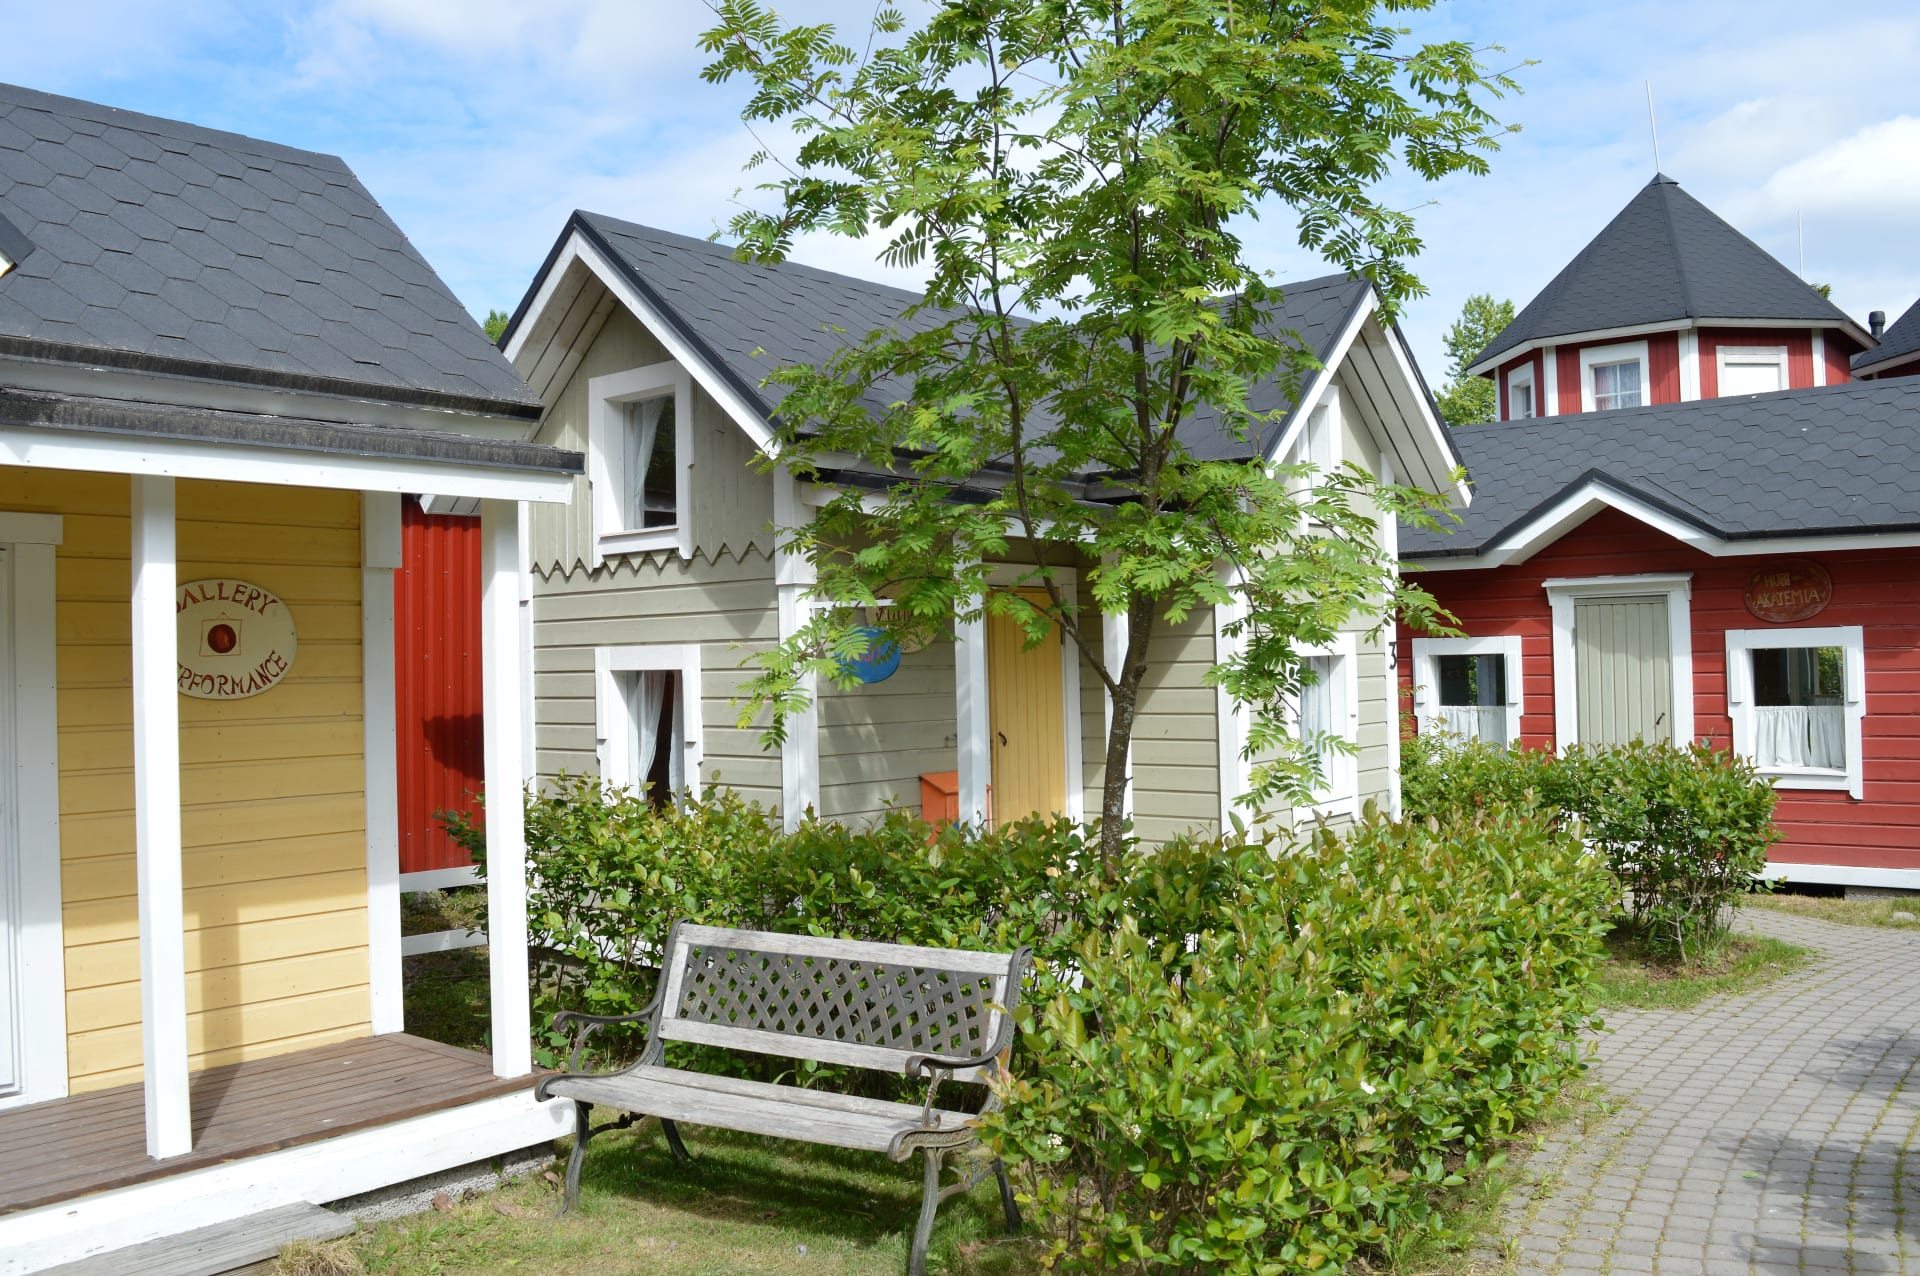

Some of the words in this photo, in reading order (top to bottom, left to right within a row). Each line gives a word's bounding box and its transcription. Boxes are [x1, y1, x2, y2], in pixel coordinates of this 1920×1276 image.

[1754, 588, 1820, 608] AKATEMIA
[1389, 642, 1397, 670] 3
[177, 650, 289, 697] RFORMANCE
